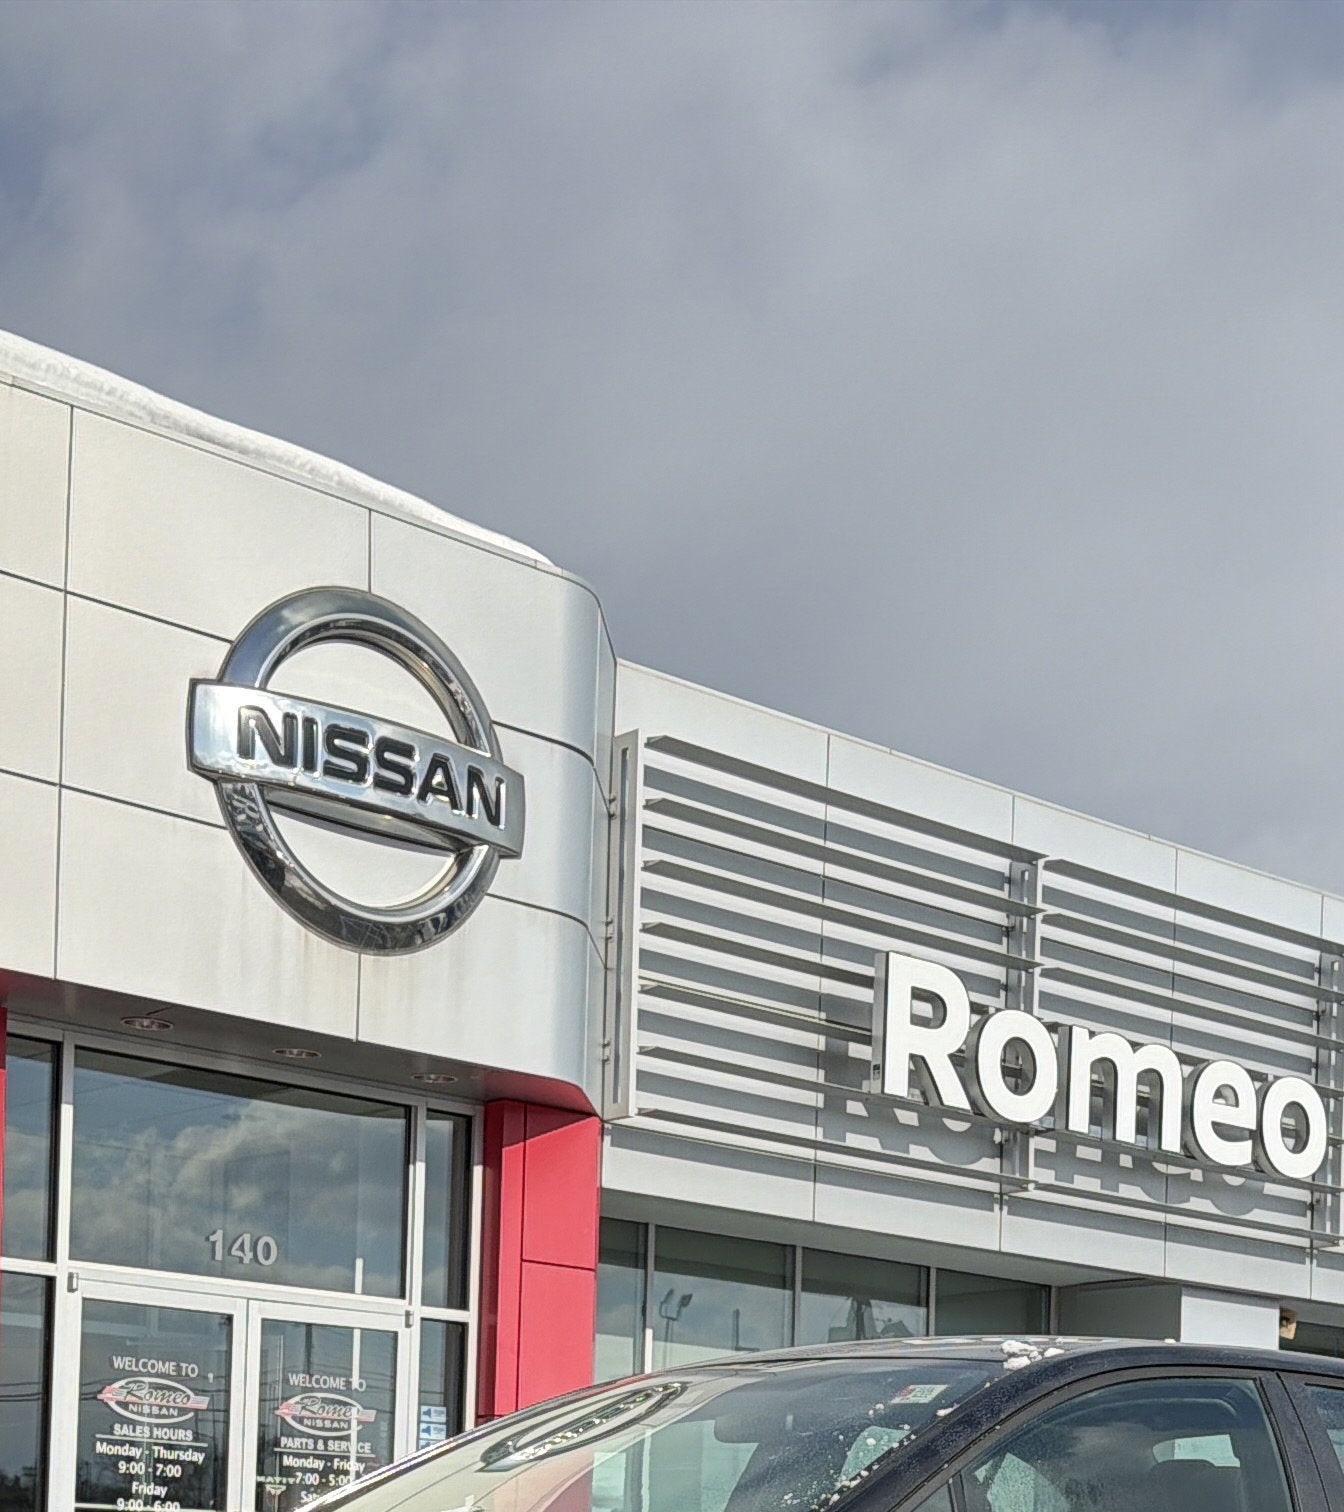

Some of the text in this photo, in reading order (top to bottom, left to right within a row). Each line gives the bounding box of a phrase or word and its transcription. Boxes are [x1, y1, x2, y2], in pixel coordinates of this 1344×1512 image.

[235, 703, 506, 831] NISSAN
[873, 950, 1328, 1180] Romeo
[208, 1229, 278, 1266] 140
[112, 1355, 199, 1378] WELCOME TO
[288, 1372, 347, 1391] WELCOME
[121, 1379, 192, 1406] Romeo
[128, 1403, 179, 1417] NISSAN
[298, 1395, 360, 1418] Rome
[113, 1423, 193, 1441] SALES HOURS
[303, 1418, 349, 1429] NISSAN
[95, 1441, 143, 1460] Monday
[152, 1446, 205, 1464] Thursday
[280, 1436, 372, 1454] PARTS & SERVCE
[118, 1461, 145, 1475] 9:00
[155, 1463, 182, 1477] 7:00
[282, 1455, 326, 1471] Monday
[333, 1457, 366, 1474] Friday
[295, 1472, 320, 1486] 7:00
[131, 1481, 168, 1498] Friday
[117, 1498, 144, 1512] 9:00
